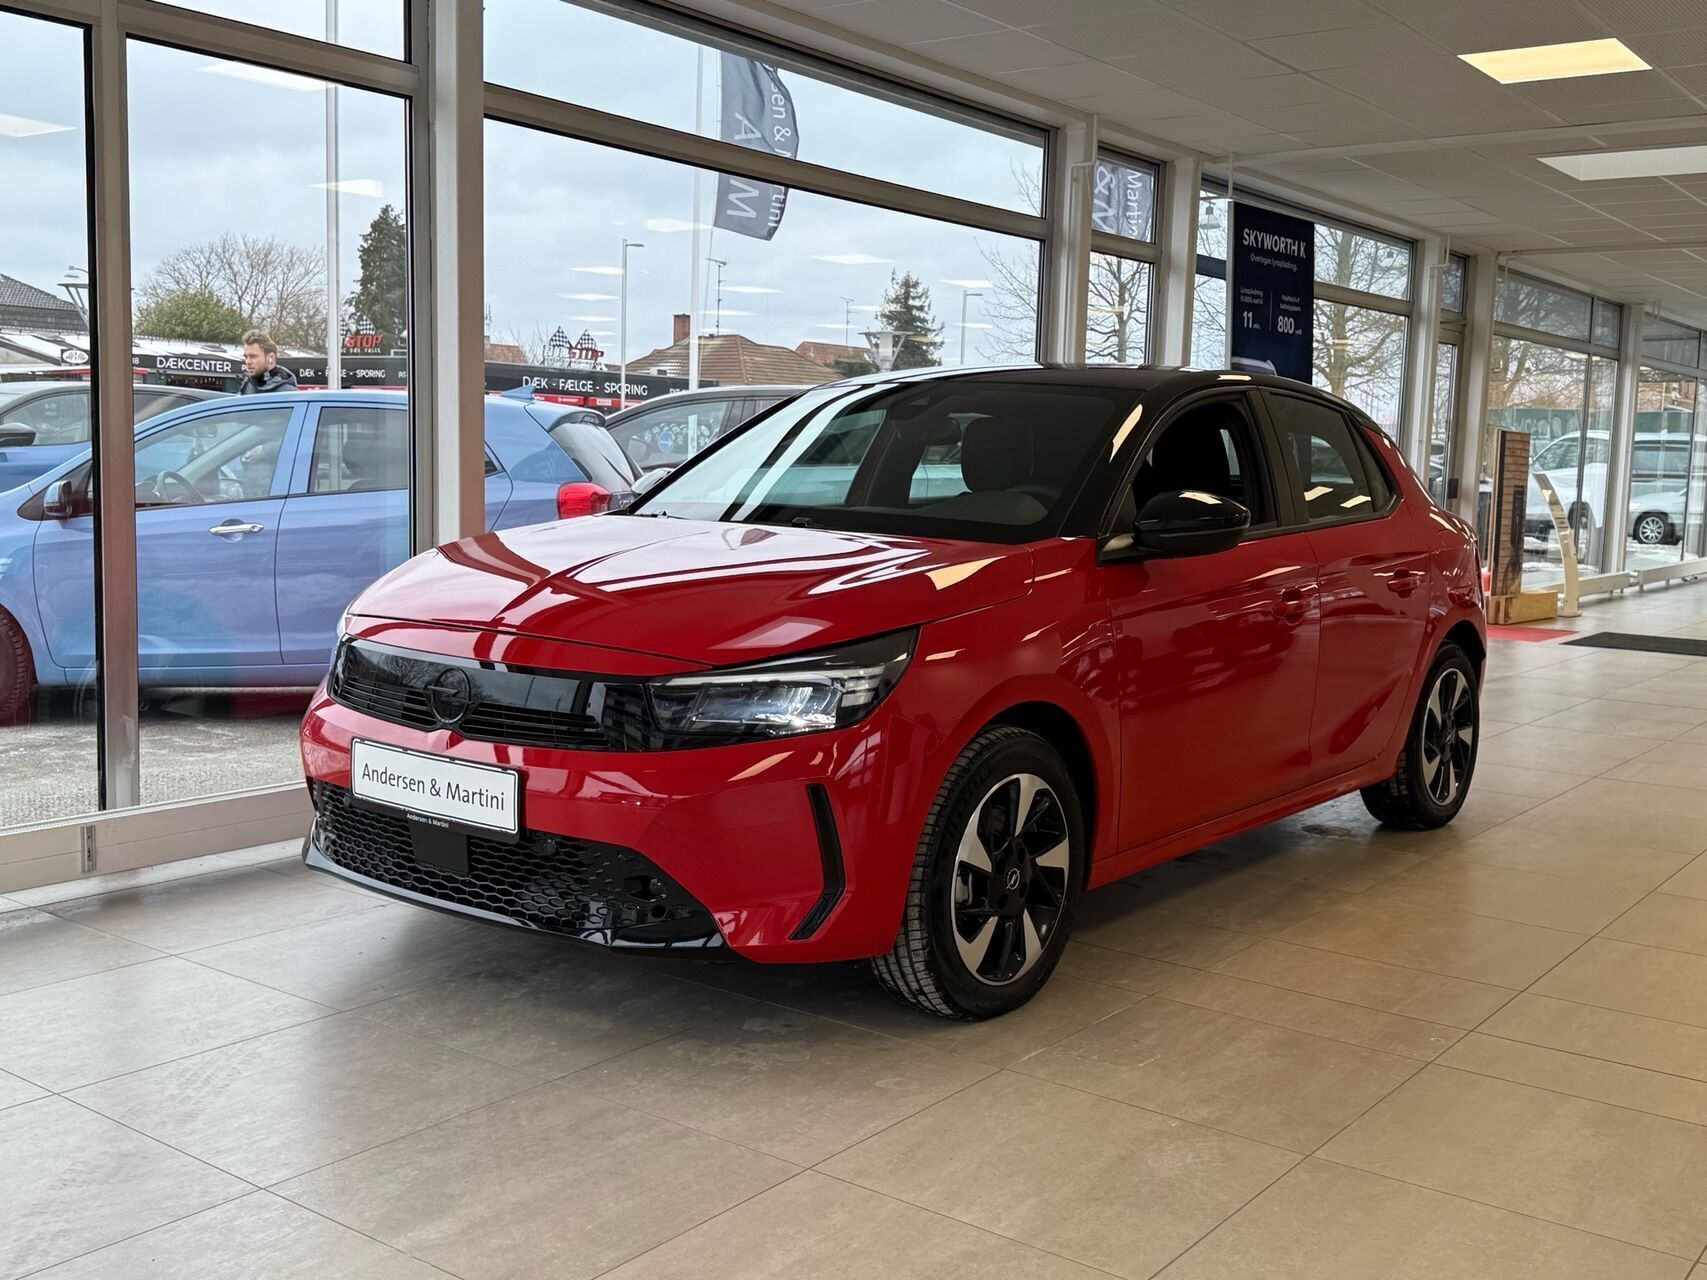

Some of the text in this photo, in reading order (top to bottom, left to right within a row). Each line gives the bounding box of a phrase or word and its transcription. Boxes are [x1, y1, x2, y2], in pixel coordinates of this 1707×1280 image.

[1243, 227, 1307, 259] SKYWORTH K
[1242, 311, 1253, 329] 11
[1277, 315, 1295, 335] 800
[345, 334, 383, 348] STOP
[156, 355, 232, 373] DÆKCENTER
[299, 368, 315, 378] DÆK
[356, 369, 386, 378] SPORING
[522, 375, 548, 389] DÆK
[559, 378, 594, 392] FÆLGE
[362, 763, 505, 811] Andersen & Martini
[406, 812, 449, 828] Andersen & Martini
